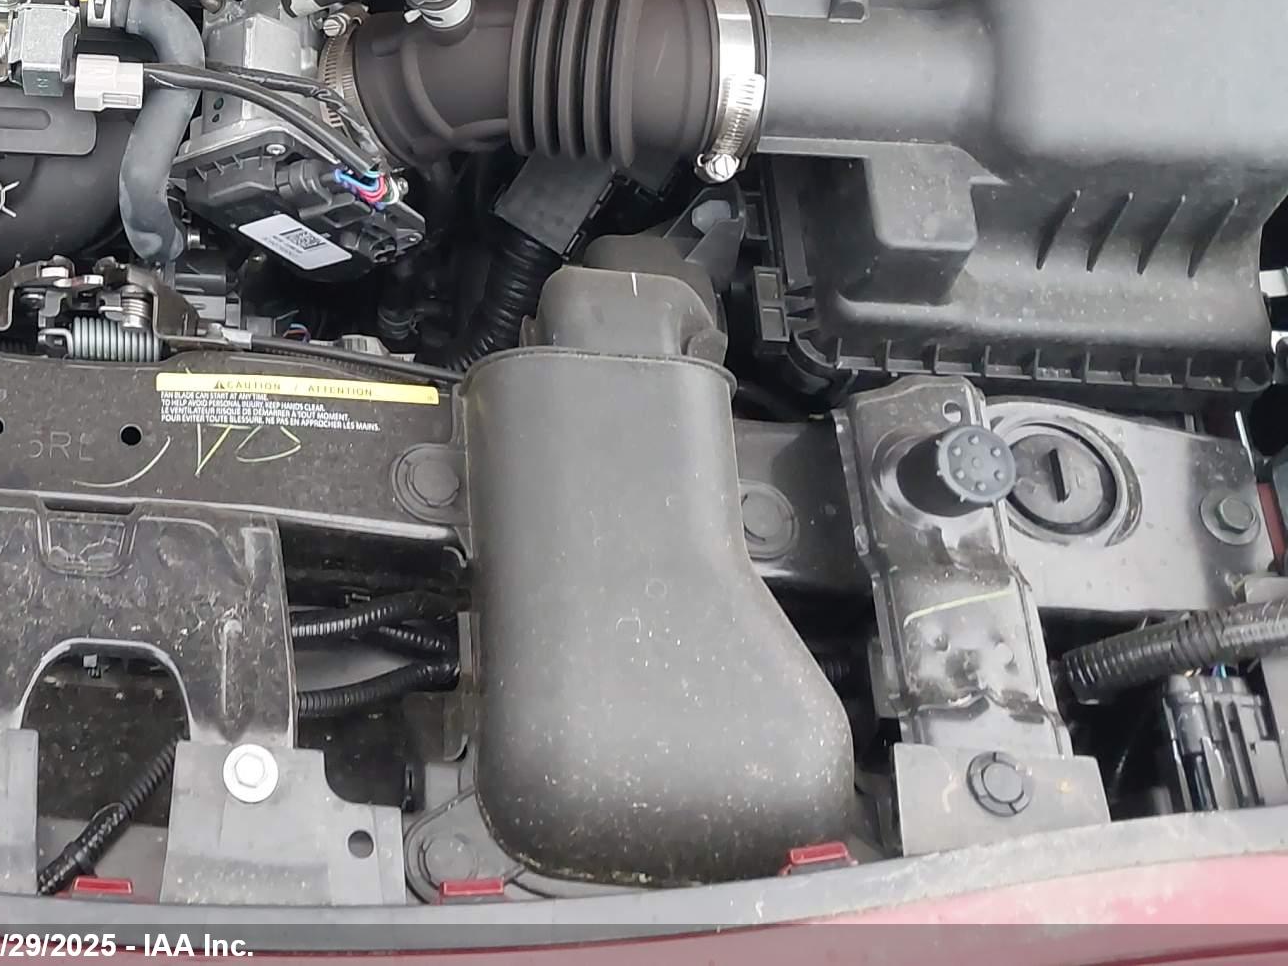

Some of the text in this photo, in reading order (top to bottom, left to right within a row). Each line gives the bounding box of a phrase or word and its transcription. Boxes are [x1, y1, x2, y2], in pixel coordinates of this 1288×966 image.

[226, 380, 281, 391] CAUTION
[307, 385, 373, 397] ATTENTION
[161, 391, 173, 399] FAN
[174, 391, 194, 400] BLADE
[195, 392, 210, 400] CAN
[210, 392, 229, 400] START
[238, 393, 252, 401] ANY
[172, 399, 188, 407] HELP
[189, 400, 208, 408] AVOID
[208, 400, 241, 408] PERSONAL
[265, 402, 280, 410] KEEP
[281, 402, 303, 411] HANDS
[161, 406, 169, 415] LE
[170, 406, 215, 415] VENTILATEUR
[216, 407, 241, 416] RISQUE
[242, 408, 252, 416] DE
[297, 410, 316, 419] TOUT
[161, 414, 182, 422] POUR
[206, 415, 229, 423] TOUTE
[265, 417, 275, 425] NE
[275, 417, 289, 426] PAS
[290, 417, 300, 426] EN
[300, 418, 342, 429] APPROCHER
